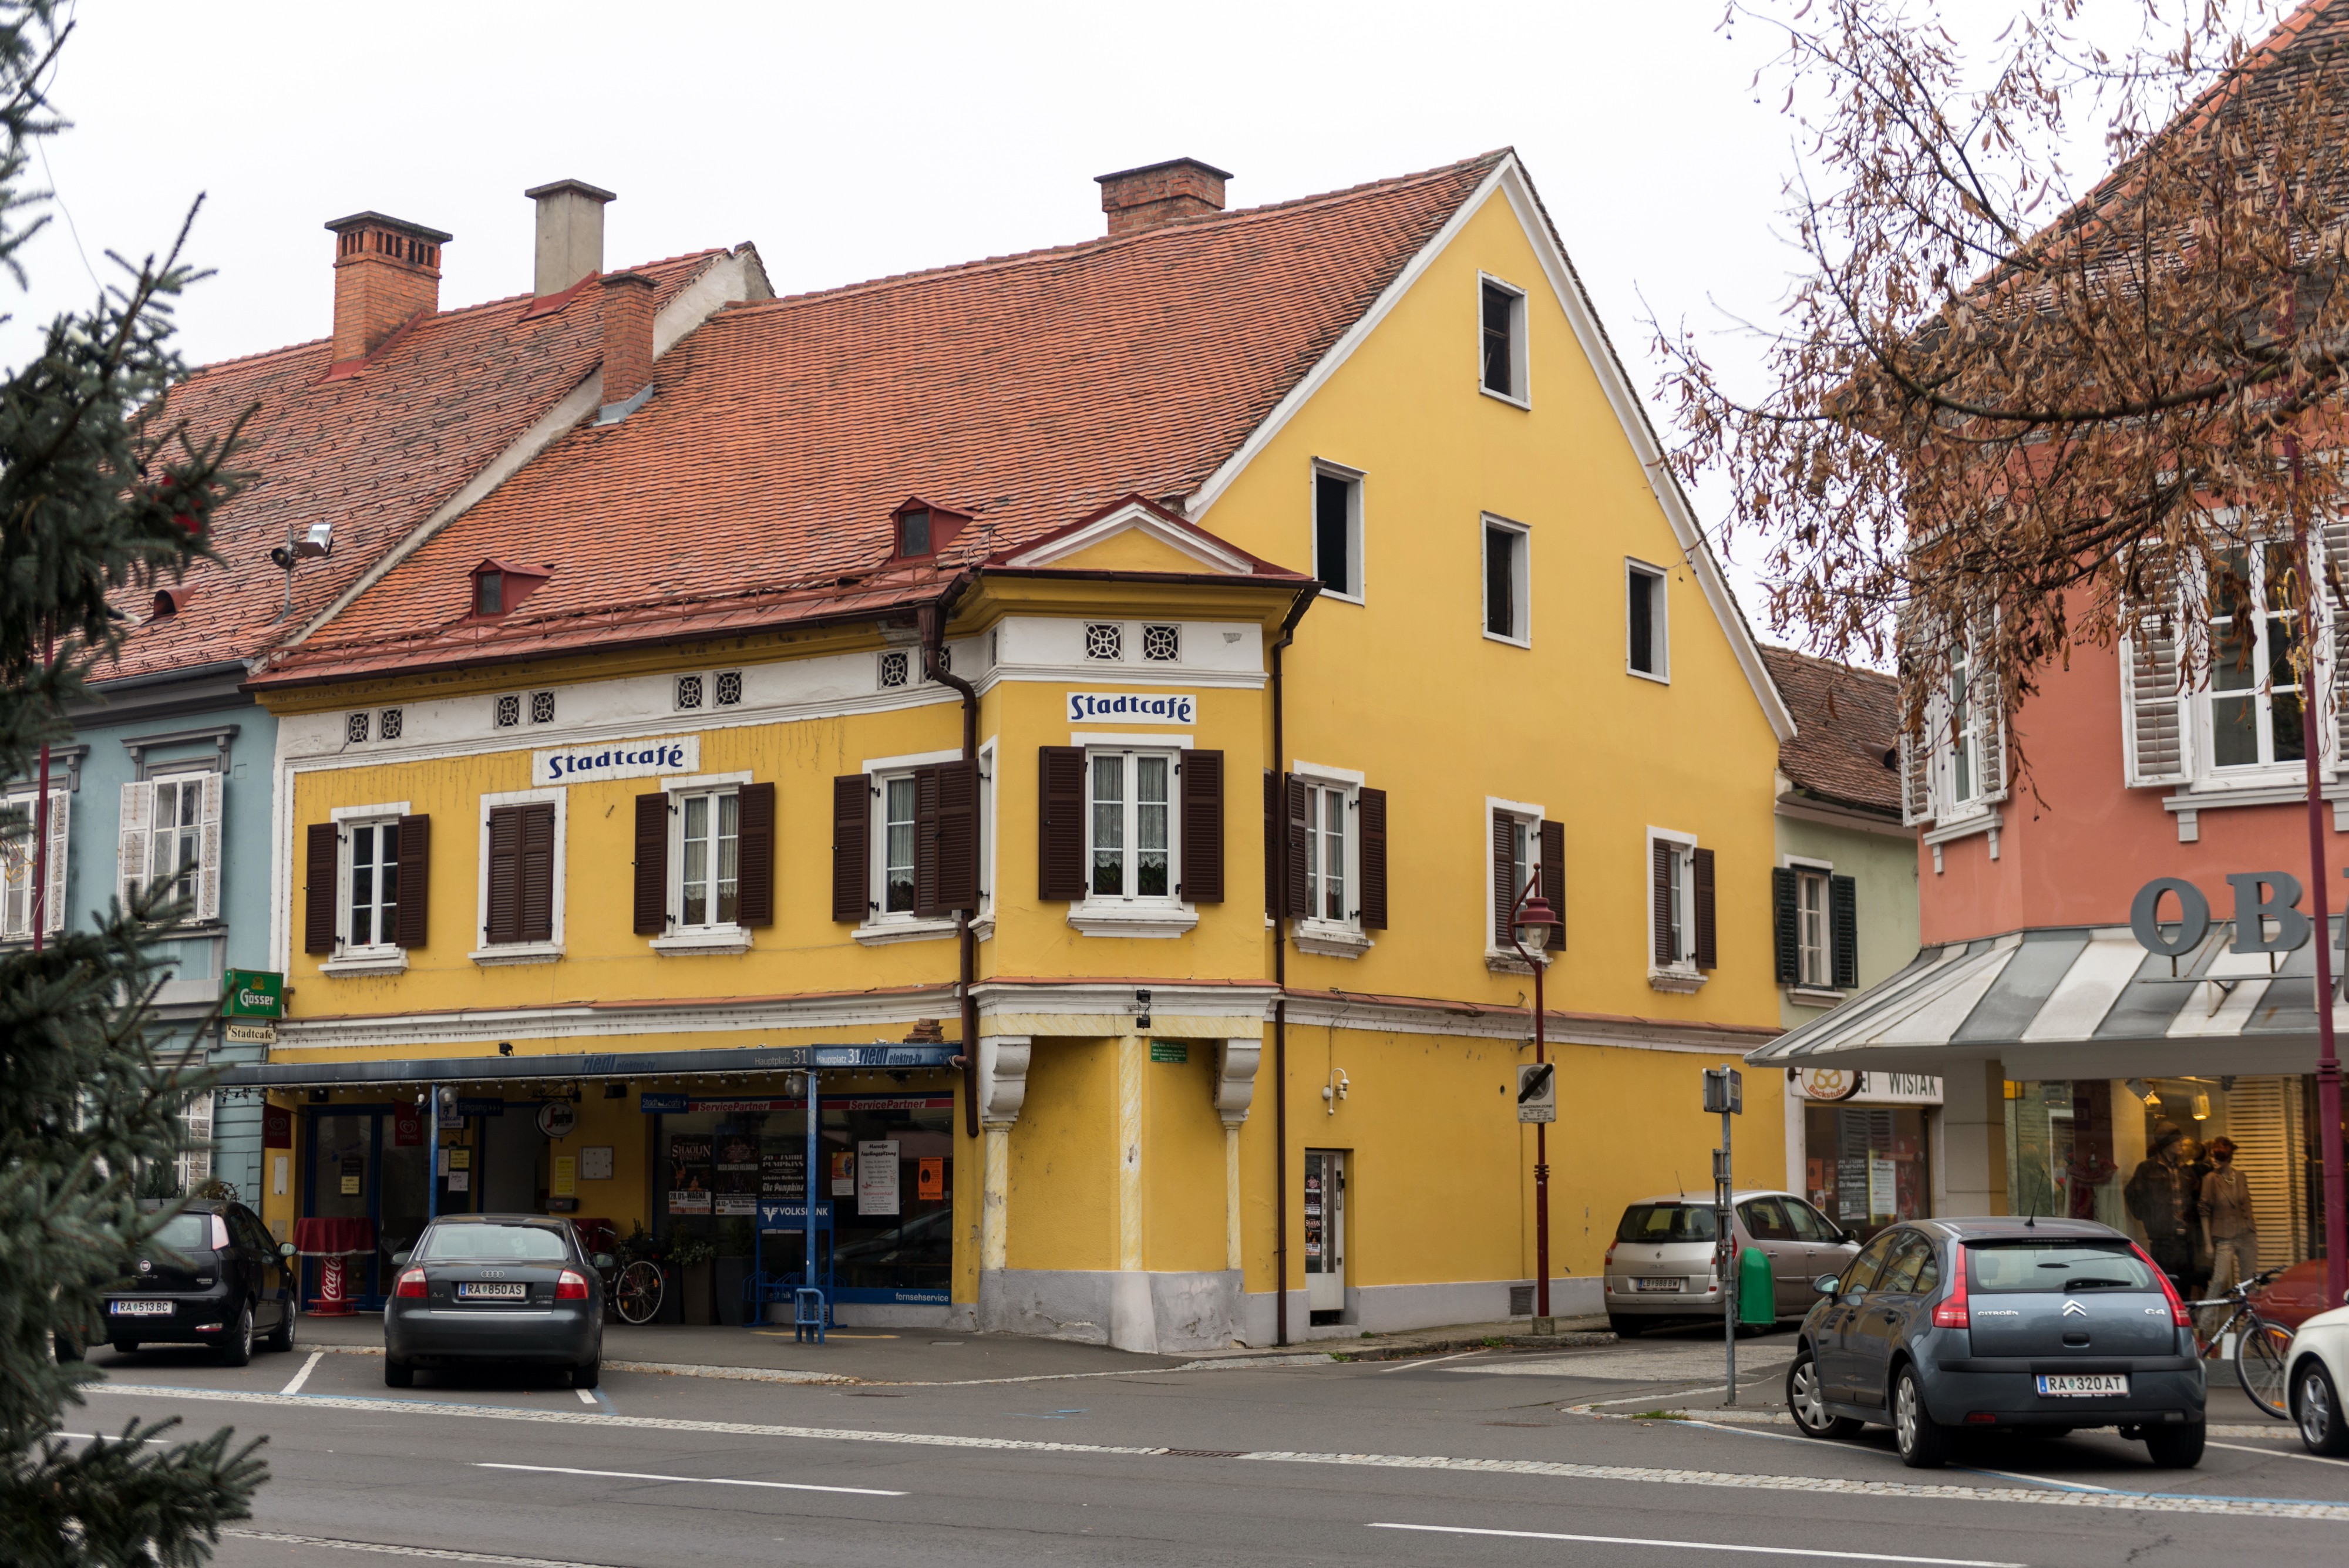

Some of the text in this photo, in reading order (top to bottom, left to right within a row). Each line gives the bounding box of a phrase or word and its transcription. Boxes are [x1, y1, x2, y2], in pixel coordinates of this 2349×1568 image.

[1071, 695, 1190, 722] Stadtcafé
[548, 744, 683, 779] Stadtcafé
[240, 988, 275, 1007] Gösser
[231, 1028, 272, 1039] Stadtcafé
[755, 1056, 790, 1066] Hauptplatz
[792, 1049, 807, 1064] 31
[816, 1055, 847, 1065] Hauptplatz
[848, 1049, 860, 1064] 31
[1808, 1084, 1847, 1098] Backstube
[460, 1102, 487, 1112] Eingang
[699, 1102, 768, 1112] ServicePartner
[851, 1100, 924, 1110] ServicePartner
[672, 1145, 711, 1158] SHAOLIN
[774, 1183, 804, 1194] Pumpkins
[780, 1207, 827, 1216] VOLKSNK
[467, 1284, 480, 1294] RA
[488, 1284, 507, 1295] 850
[509, 1285, 521, 1295] AS
[896, 1291, 948, 1302] fernsehservice
[120, 1303, 132, 1311] RA
[139, 1303, 154, 1311] 513
[157, 1303, 168, 1311] BC
[2049, 1377, 2067, 1391] RA
[2077, 1377, 2102, 1390] 320
[2105, 1377, 2121, 1390] AT
